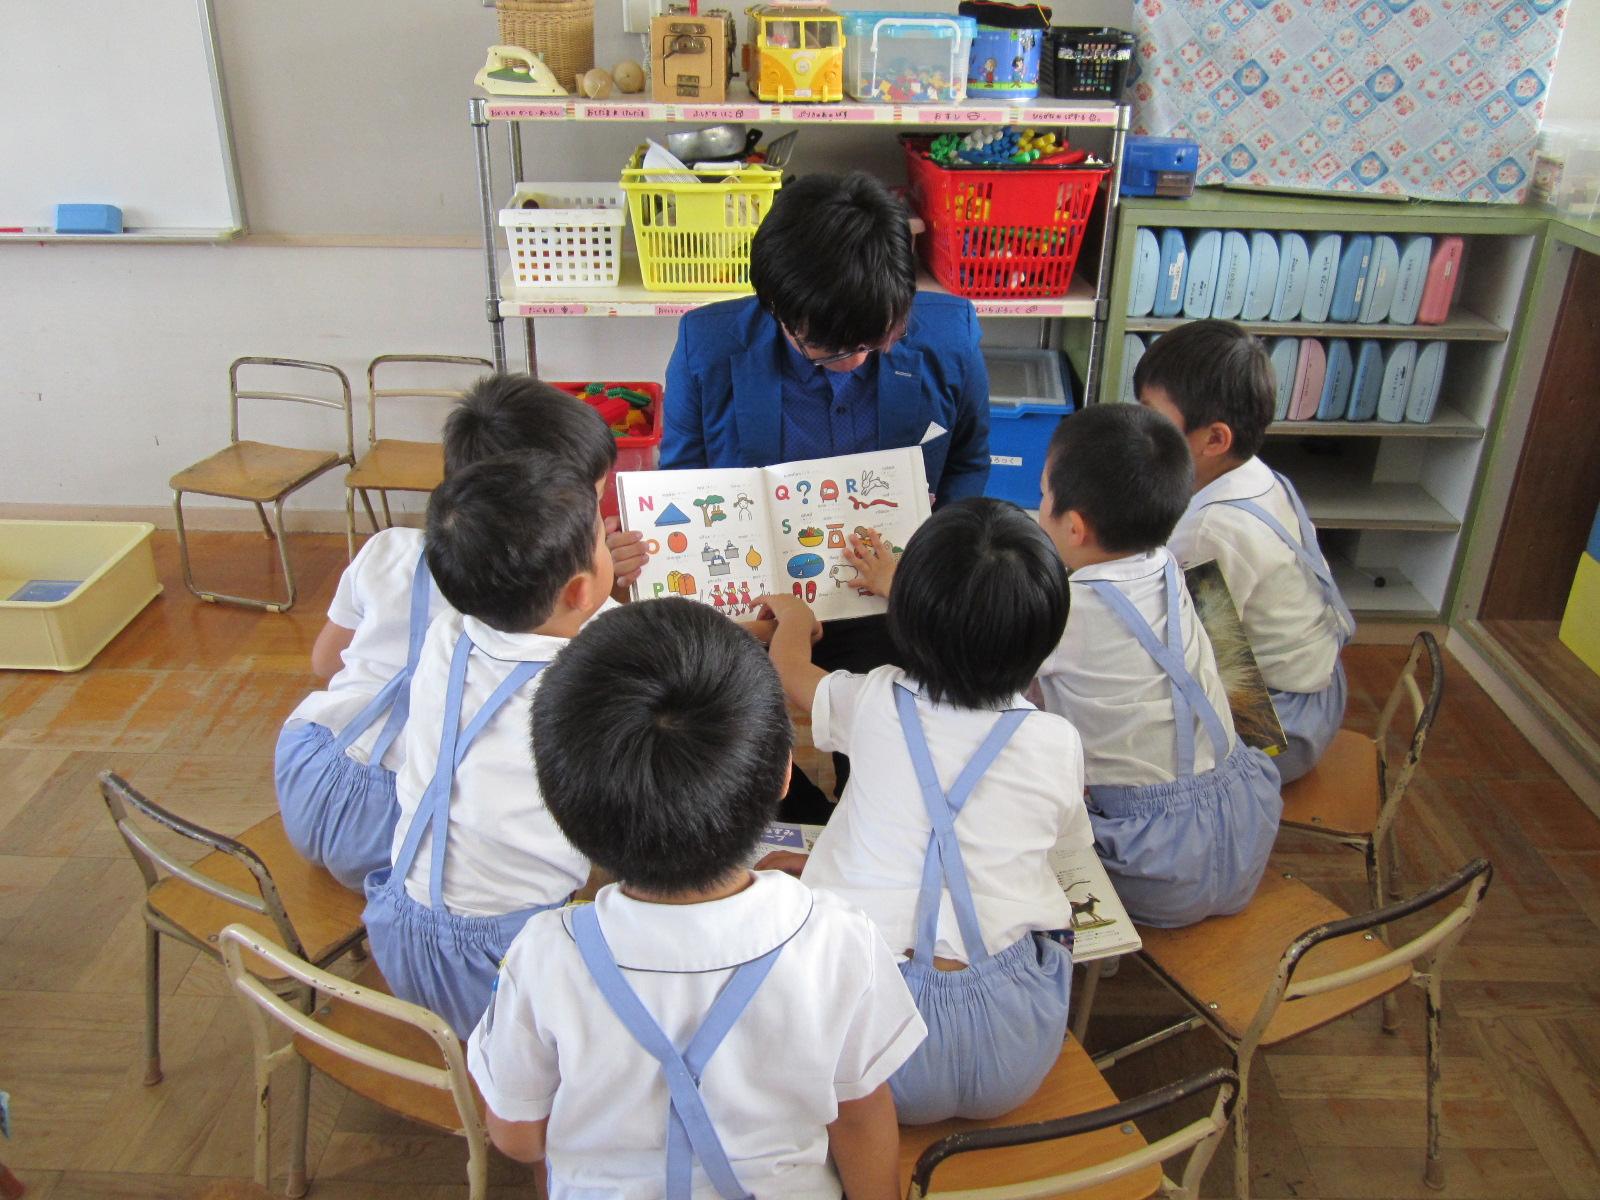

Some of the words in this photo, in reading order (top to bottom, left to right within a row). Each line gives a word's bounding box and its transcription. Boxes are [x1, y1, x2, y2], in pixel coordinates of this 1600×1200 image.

[775, 485, 790, 501] Q
[845, 479, 858, 494] R
[638, 496, 654, 512] N
[782, 518, 791, 534] S
[645, 539, 660, 555] O
[653, 582, 664, 598] P
